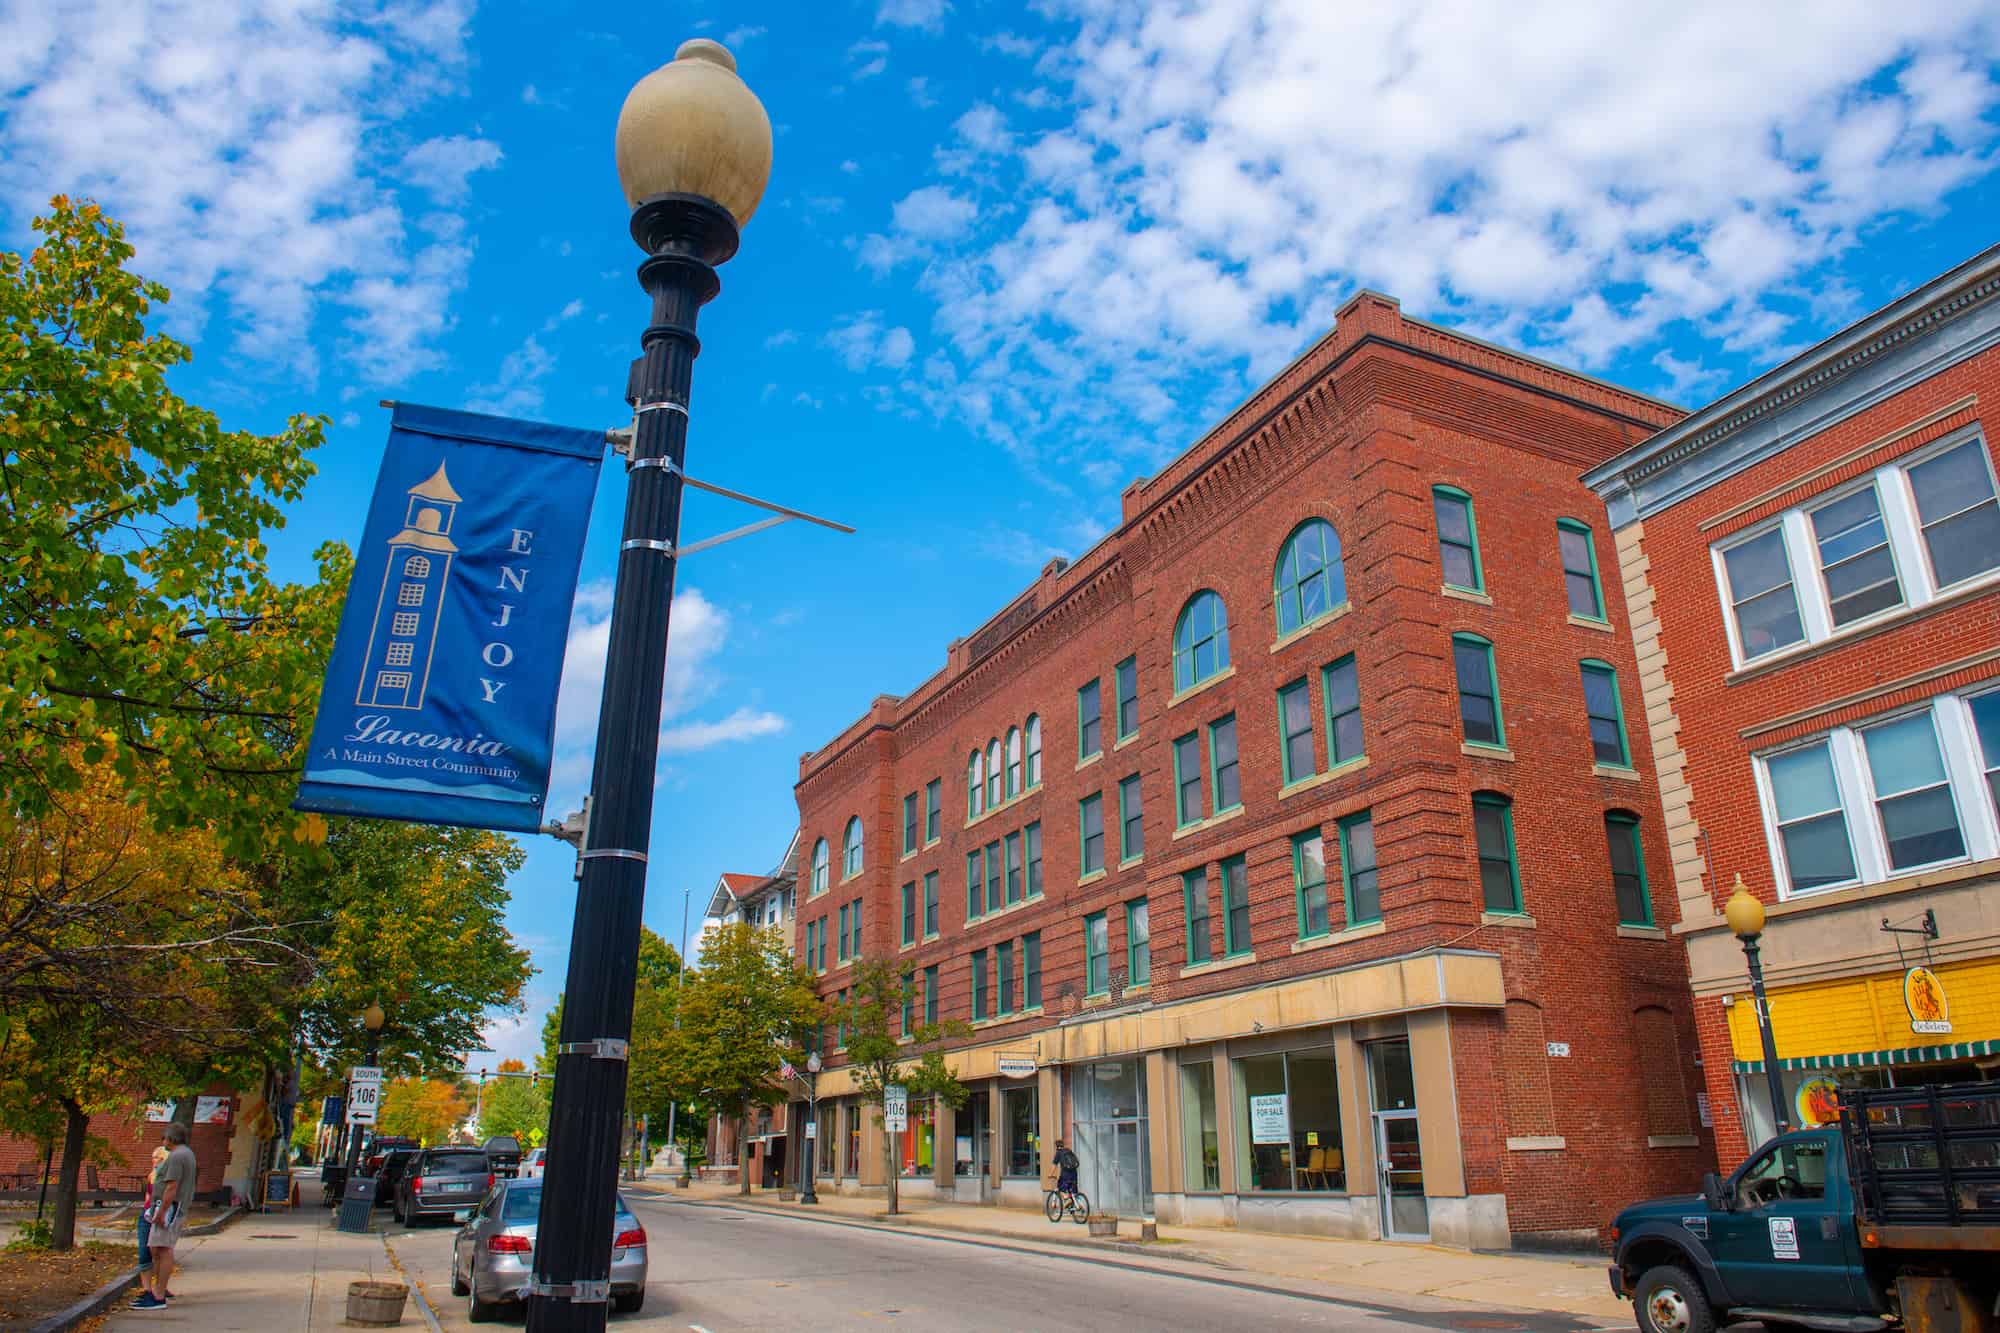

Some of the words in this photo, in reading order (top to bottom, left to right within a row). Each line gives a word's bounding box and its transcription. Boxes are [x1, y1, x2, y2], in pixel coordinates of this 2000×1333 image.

[479, 528, 534, 704] ENJOY
[343, 714, 512, 757] Laconia
[323, 747, 338, 761] A
[342, 749, 381, 764] Main
[384, 752, 429, 769] Street
[432, 757, 521, 782] Community
[355, 1070, 380, 1079] SOUTH
[356, 1087, 376, 1105] 106
[1256, 1097, 1282, 1106] BUILDING
[889, 1102, 905, 1116] 106
[1256, 1107, 1269, 1117] FOR
[1269, 1106, 1284, 1116] SALE
